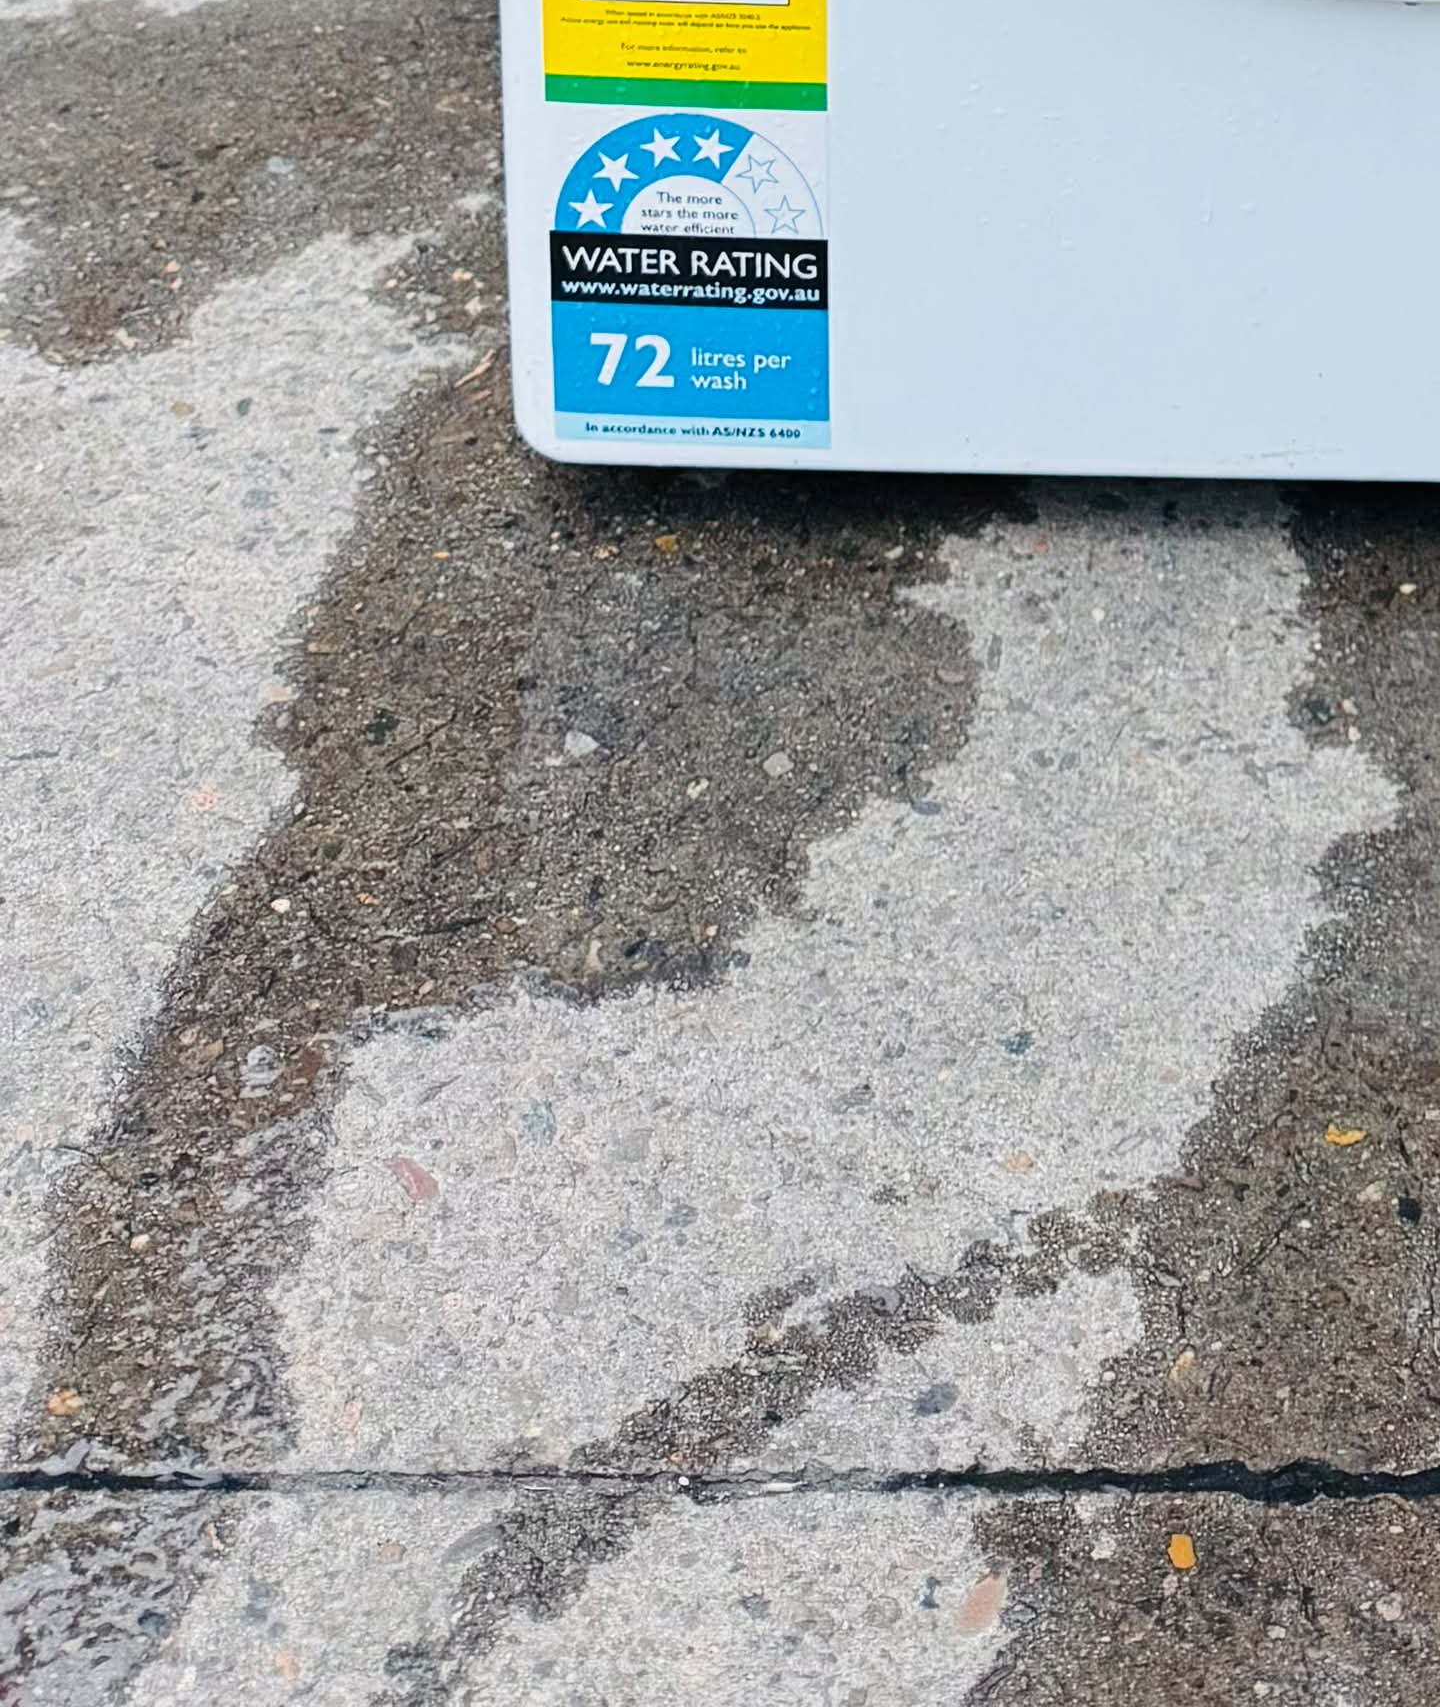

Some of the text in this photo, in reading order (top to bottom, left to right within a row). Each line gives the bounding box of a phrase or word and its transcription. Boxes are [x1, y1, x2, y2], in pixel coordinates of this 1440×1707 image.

[657, 191, 722, 206] The more
[641, 208, 739, 221] stars the more
[641, 223, 735, 235] water efficient
[562, 245, 818, 280] WATER RATING
[562, 280, 821, 305] www.waterrating.gov.au
[590, 332, 675, 388] 72
[691, 348, 792, 370] litres per
[690, 371, 747, 390] wash
[586, 422, 801, 439] In accordance with AS/NZS 6400
